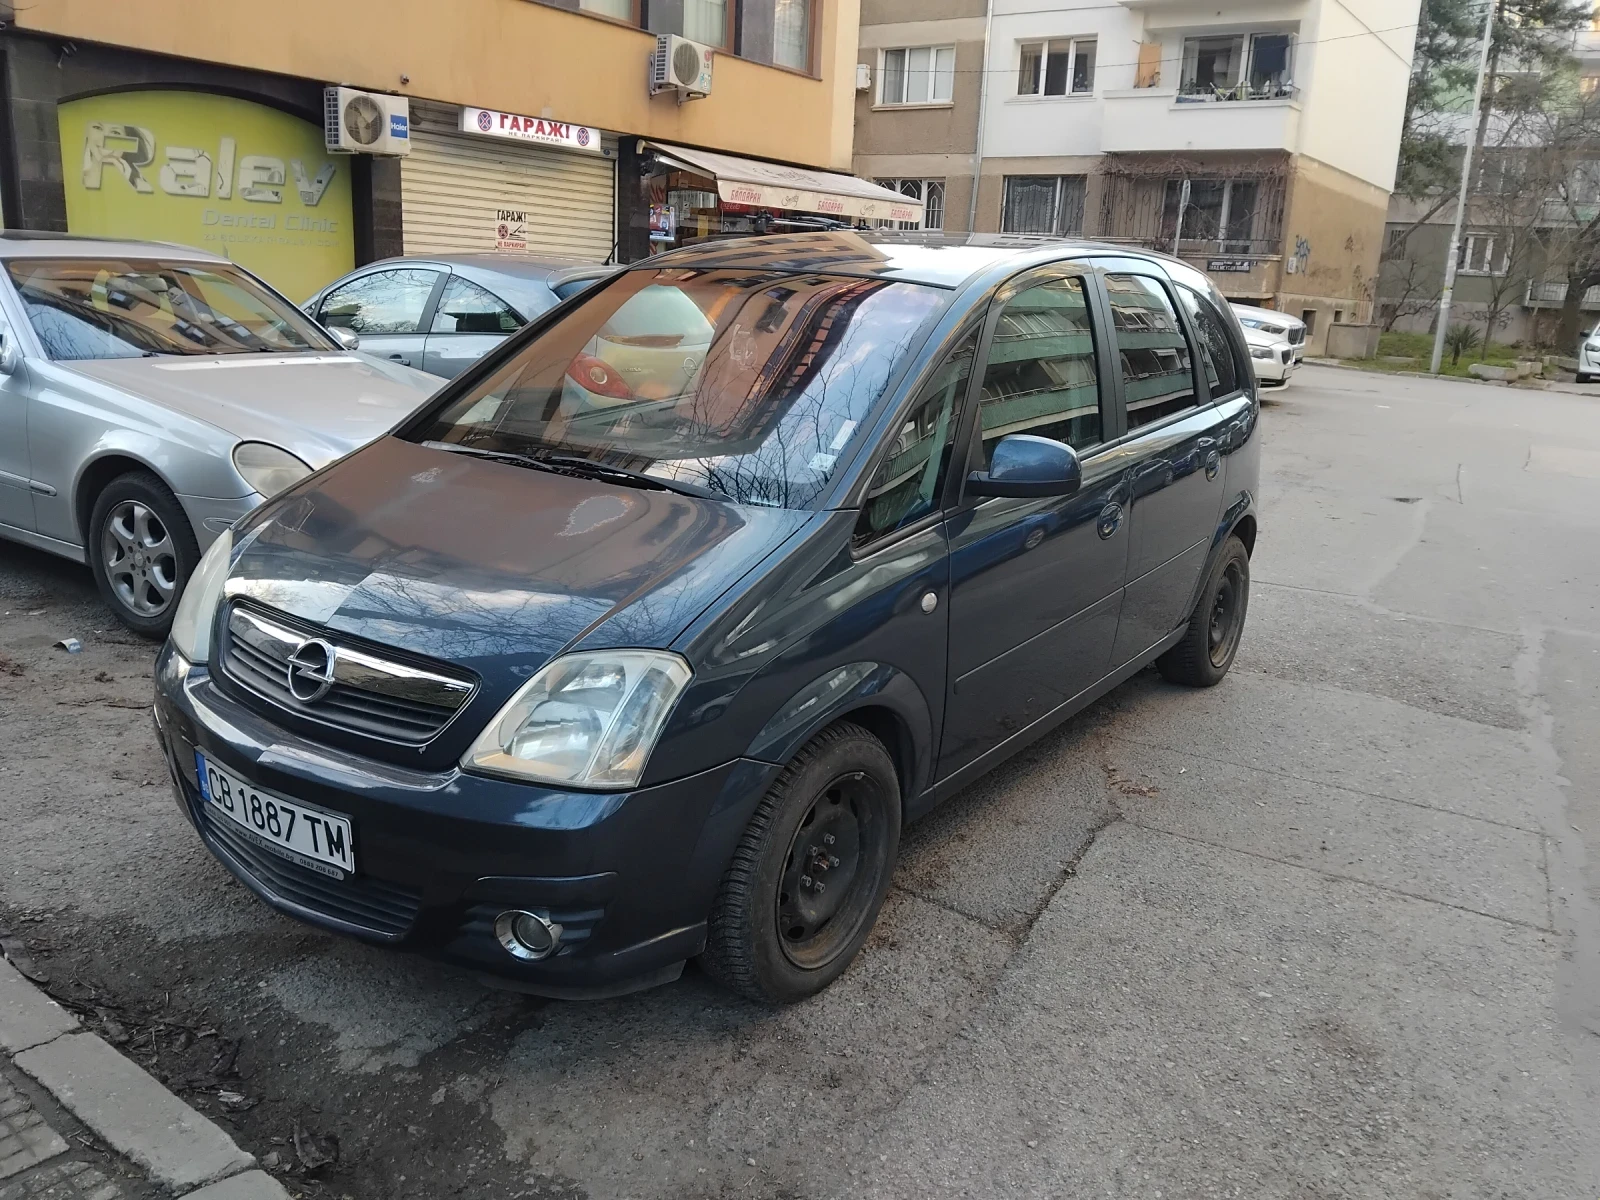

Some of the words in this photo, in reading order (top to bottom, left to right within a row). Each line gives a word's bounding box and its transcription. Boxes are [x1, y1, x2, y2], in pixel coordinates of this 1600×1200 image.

[390, 122, 408, 131] Haier
[500, 113, 570, 139] ГАРАЖ!
[82, 120, 336, 206] Ralev
[202, 208, 276, 230] Dental
[284, 215, 339, 233] Clinic
[497, 209, 527, 223] ГАРАЖ!
[208, 767, 234, 812] CB
[237, 787, 296, 842] 1887
[303, 813, 346, 862] TM
